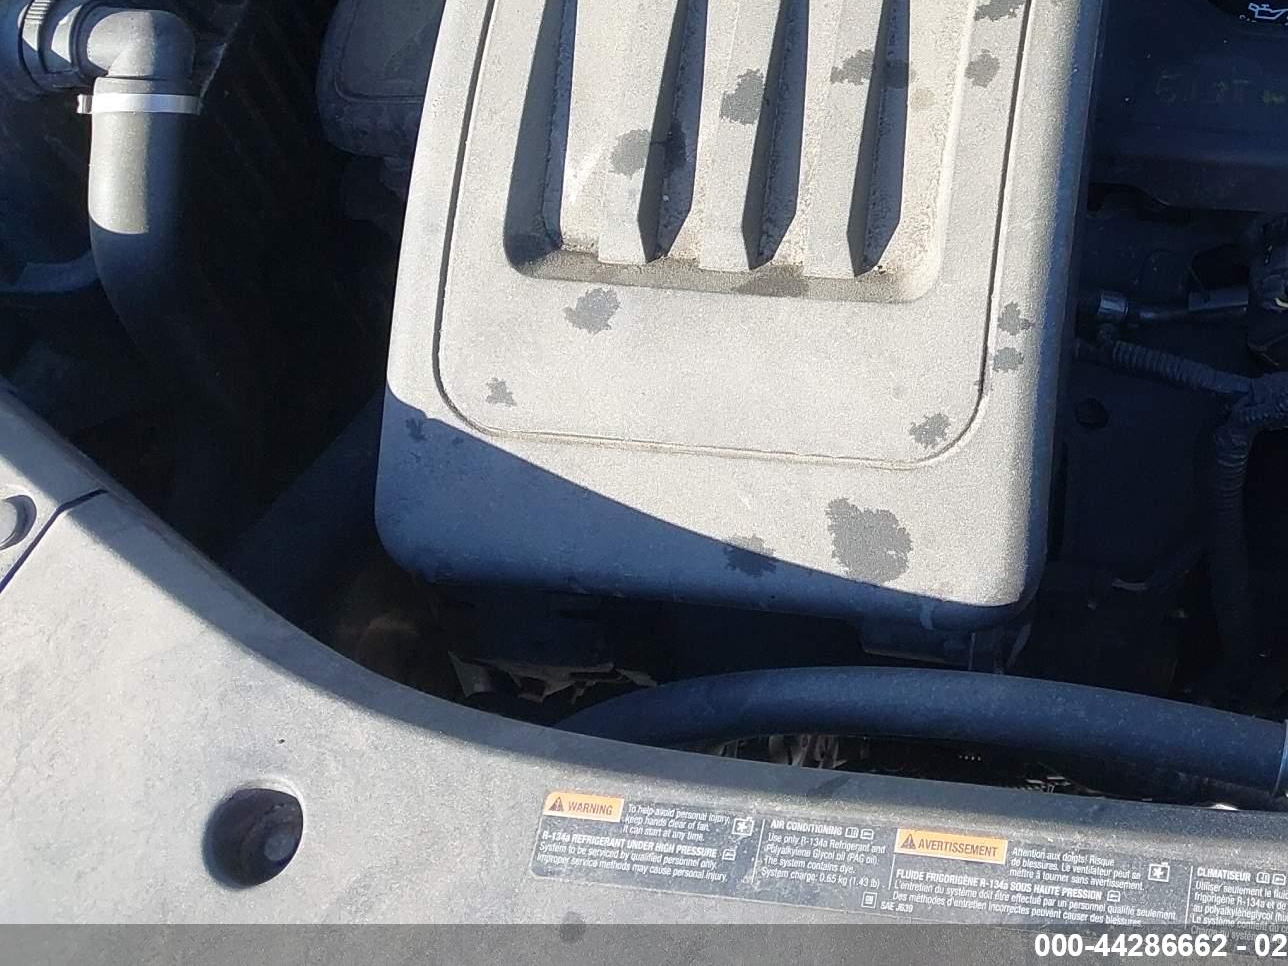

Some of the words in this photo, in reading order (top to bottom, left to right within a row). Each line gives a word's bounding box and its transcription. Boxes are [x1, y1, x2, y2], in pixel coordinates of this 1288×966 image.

[568, 800, 614, 816] WARNING
[629, 804, 636, 813] To
[676, 810, 707, 822] personal
[625, 816, 642, 828] keep
[644, 817, 666, 829] hands
[668, 820, 686, 830] clear
[687, 822, 695, 830] of
[645, 828, 661, 836] start
[771, 819, 785, 830] AIR
[787, 821, 842, 836] CONDITIONING
[542, 831, 570, 844] R-134a
[572, 834, 625, 849] REFRIGERANT
[627, 839, 653, 851] UNDER
[655, 842, 674, 853] HIGH
[676, 844, 717, 858] PRESSURE
[768, 833, 782, 843] Use
[784, 835, 799, 846] only
[801, 837, 828, 848] R-134a
[830, 839, 869, 852] Refrigerant
[871, 843, 886, 854] and
[918, 838, 998, 858] AVERTISSEMENT
[539, 841, 567, 854] System
[569, 845, 575, 853] to
[577, 846, 587, 855] be
[588, 847, 618, 859] serviced
[620, 850, 629, 862] by
[631, 851, 662, 864] qualified
[663, 855, 696, 868] personnel
[698, 859, 717, 870] only.
[766, 845, 811, 857] Polyalkylene
[813, 849, 835, 862] Glycol
[847, 852, 865, 865] (PAG
[1012, 847, 1045, 859] Attention
[1047, 852, 1061, 860] aux
[1089, 854, 1114, 866] Risque
[537, 853, 569, 867] Improper
[570, 857, 597, 867] service
[600, 859, 630, 871] methods
[632, 862, 647, 874] may
[649, 864, 671, 875] cause
[672, 867, 704, 879] personal
[705, 869, 728, 882] injury.
[765, 856, 778, 865] The
[780, 857, 805, 869] system
[807, 861, 838, 872] contains
[840, 864, 855, 874] dye.
[1011, 858, 1021, 867] de
[1023, 858, 1058, 871] blessures.
[1062, 862, 1071, 872] Le
[1073, 864, 1112, 877] ventilateur
[1112, 866, 1130, 879] peut
[1197, 867, 1251, 881] CLIMATISEUR
[762, 867, 789, 879] System
[791, 871, 817, 883] charge:
[820, 873, 835, 883] 0.65
[838, 874, 849, 886] kg
[850, 876, 869, 888] (1.43
[897, 869, 924, 880] FLUIDE
[980, 878, 1008, 890] R-134a
[1010, 881, 1031, 892] SOUS
[1034, 883, 1060, 896] HAUTE
[1062, 886, 1102, 901] PRESSION
[1010, 868, 1034, 879] mettre
[1043, 872, 1069, 883] tourner
[1071, 875, 1089, 885] sans
[1091, 878, 1144, 891] avertissement.
[895, 880, 933, 893] L'entretien
[934, 885, 944, 894] du
[946, 886, 976, 899] système
[978, 888, 993, 899] doit
[994, 889, 1009, 901] être
[1011, 892, 1042, 905] effectué
[1044, 896, 1056, 907] par
[1069, 900, 1106, 913] personnel
[1108, 904, 1134, 916] qualifié
[1196, 881, 1222, 892] Utiliser
[1223, 884, 1263, 896] seulement
[881, 902, 896, 911] SAE
[897, 903, 913, 913] J639
[893, 891, 907, 901] Des
[909, 893, 945, 906] méthodes
[947, 896, 987, 911] d'entretien
[988, 902, 1029, 916] incorrectes
[1031, 906, 1061, 919] peuvent
[1063, 911, 1088, 923] causer
[1089, 914, 1104, 924] des
[1194, 892, 1235, 904] frigorigène
[1236, 897, 1265, 908] R-134a
[1277, 901, 1286, 910] de
[1192, 914, 1202, 923] Le
